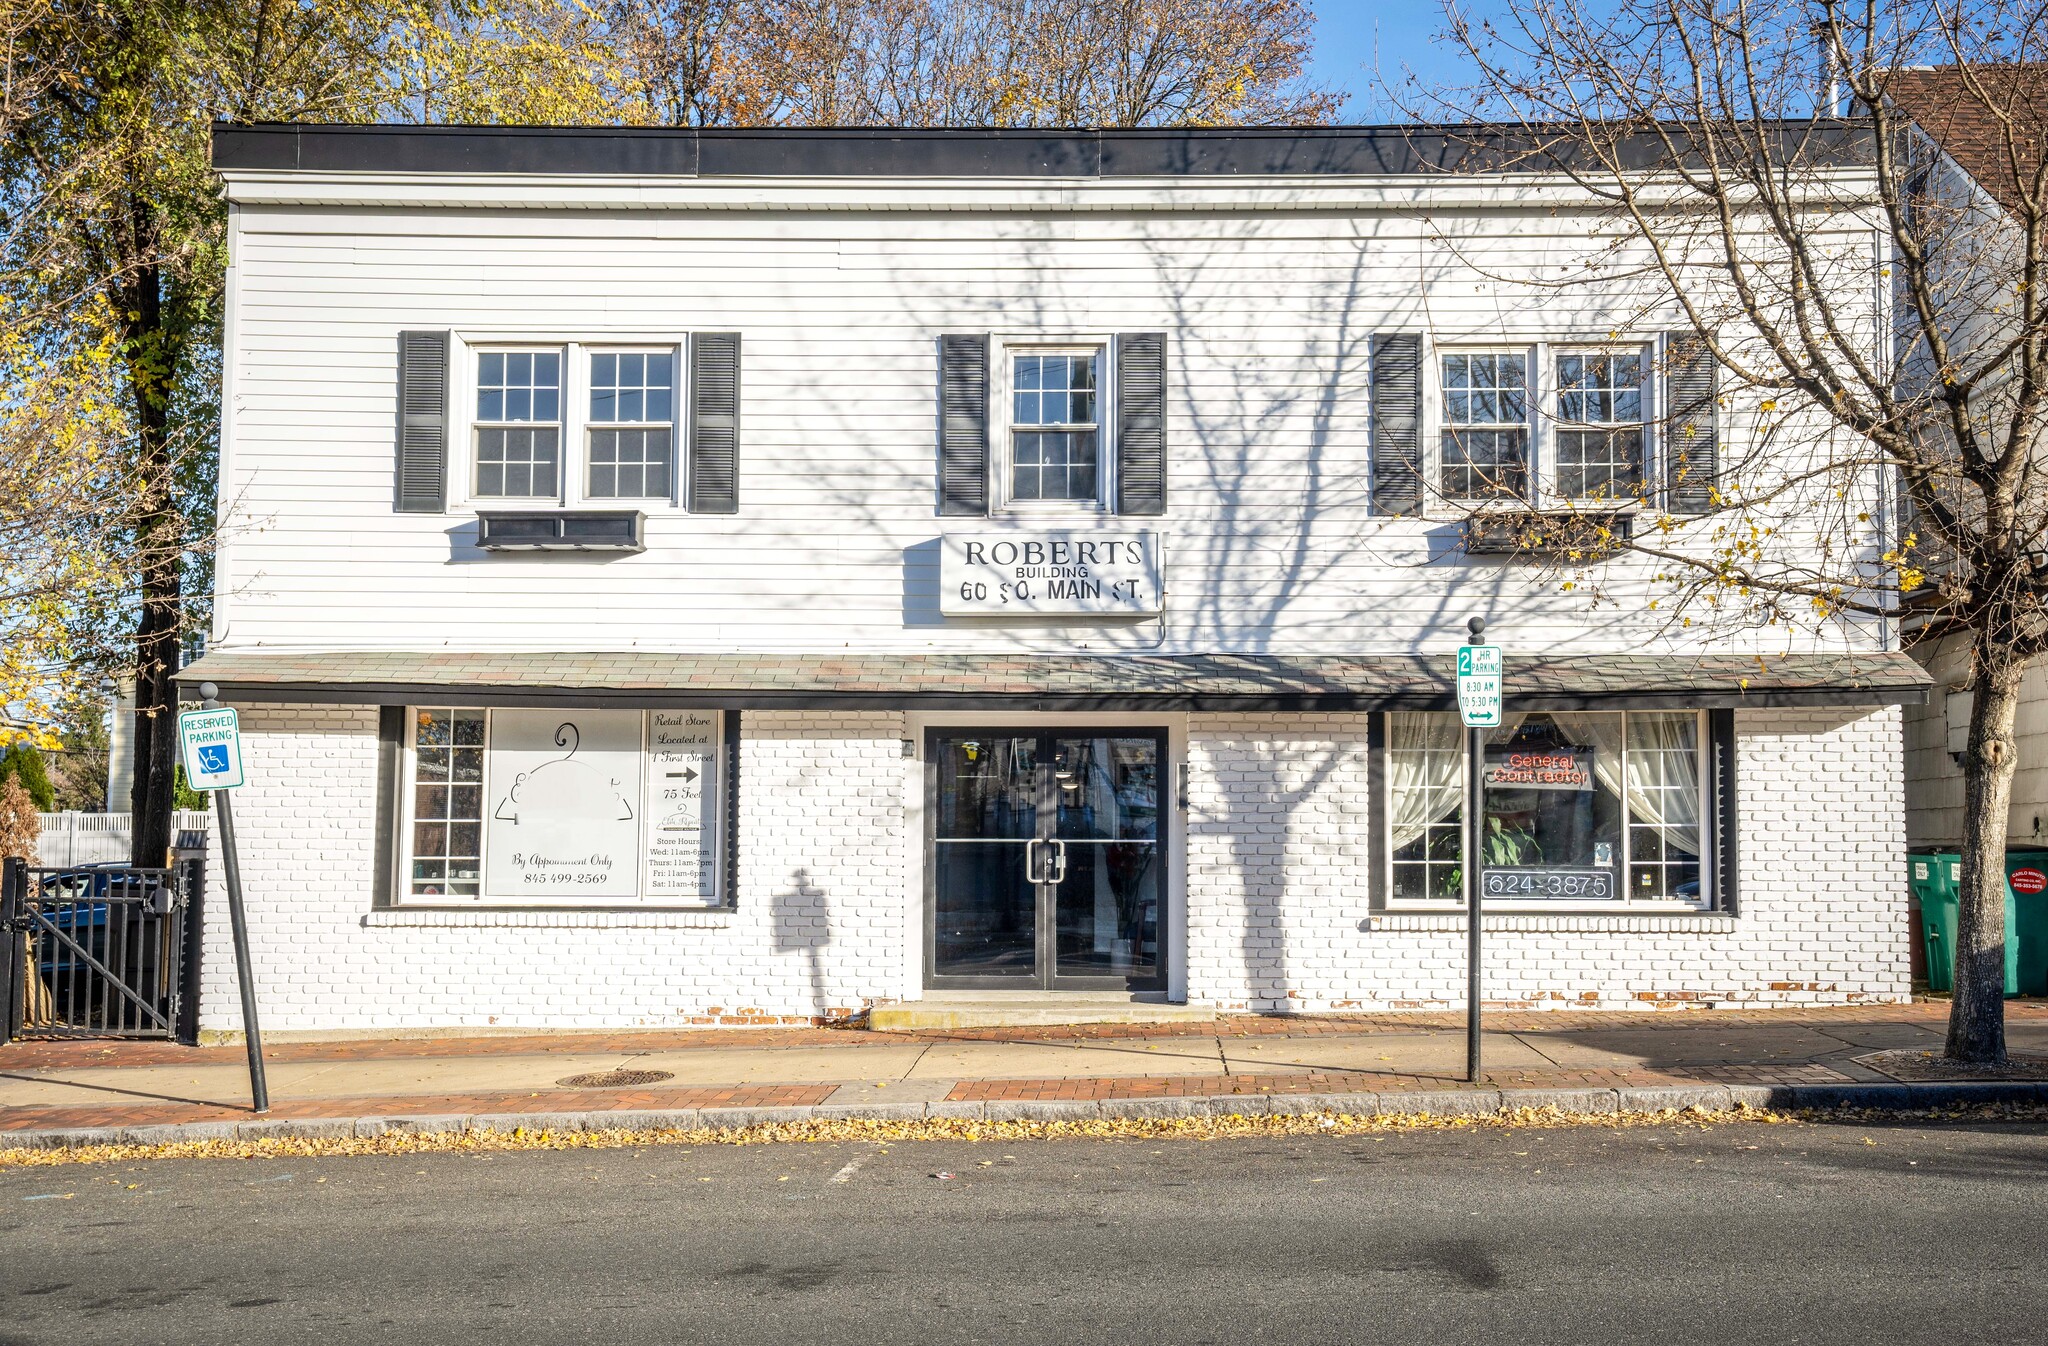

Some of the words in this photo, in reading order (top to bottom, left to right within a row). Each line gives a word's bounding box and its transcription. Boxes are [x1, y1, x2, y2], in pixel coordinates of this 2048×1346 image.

[963, 541, 1143, 565] ROBERTS
[1015, 567, 1089, 578] BUILDING
[960, 581, 987, 601] 60
[1048, 579, 1100, 600] MAIN
[1460, 652, 1470, 672] 2
[1480, 650, 1491, 660] HR
[1471, 662, 1499, 673] PARKING
[1466, 681, 1481, 692] 8:30
[1484, 681, 1494, 691] AM
[1462, 696, 1469, 707] TO
[1471, 696, 1486, 707] 5:30
[1488, 696, 1498, 707] PM
[184, 716, 234, 731] RESERVED
[655, 713, 683, 726] Retail
[685, 713, 711, 726] Store
[189, 730, 232, 744] PARKING
[657, 732, 696, 744] Located
[698, 735, 708, 744] at
[652, 752, 657, 763] 1
[661, 750, 683, 763] First
[687, 750, 714, 763] Street
[1510, 754, 1575, 769] General
[1493, 768, 1588, 784] Contractor
[664, 789, 678, 800] 75
[682, 787, 702, 800] Feet
[650, 848, 669, 856] Wed:
[671, 848, 710, 857] 11am-6pm
[512, 853, 526, 870] By
[590, 853, 612, 870] Only
[674, 859, 713, 868] 11am-7pm
[523, 873, 547, 884] 845
[550, 873, 608, 884] 499-2569
[653, 869, 666, 877] Fri:
[652, 880, 666, 888] Sat:
[1489, 875, 1606, 896] 624-3875
